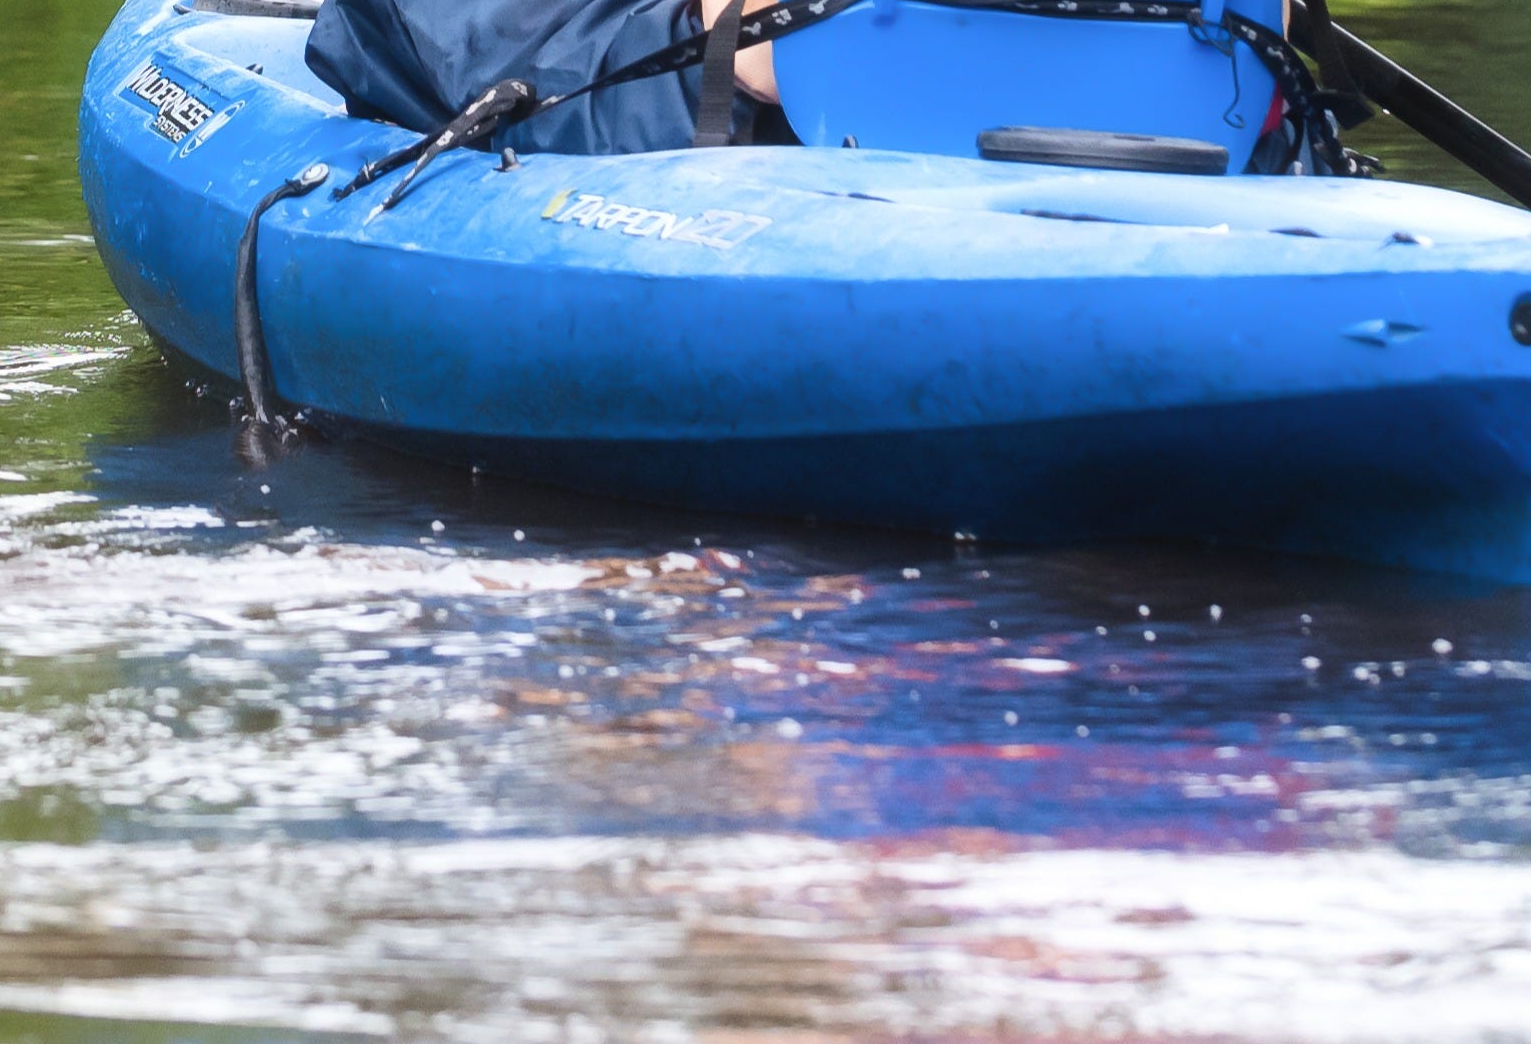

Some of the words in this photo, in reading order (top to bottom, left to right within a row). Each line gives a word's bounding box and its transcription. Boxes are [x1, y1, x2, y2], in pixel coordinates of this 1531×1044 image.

[130, 63, 214, 131] WILDERNESS
[154, 116, 187, 143] SYSTEMS
[555, 194, 694, 239] TARPON
